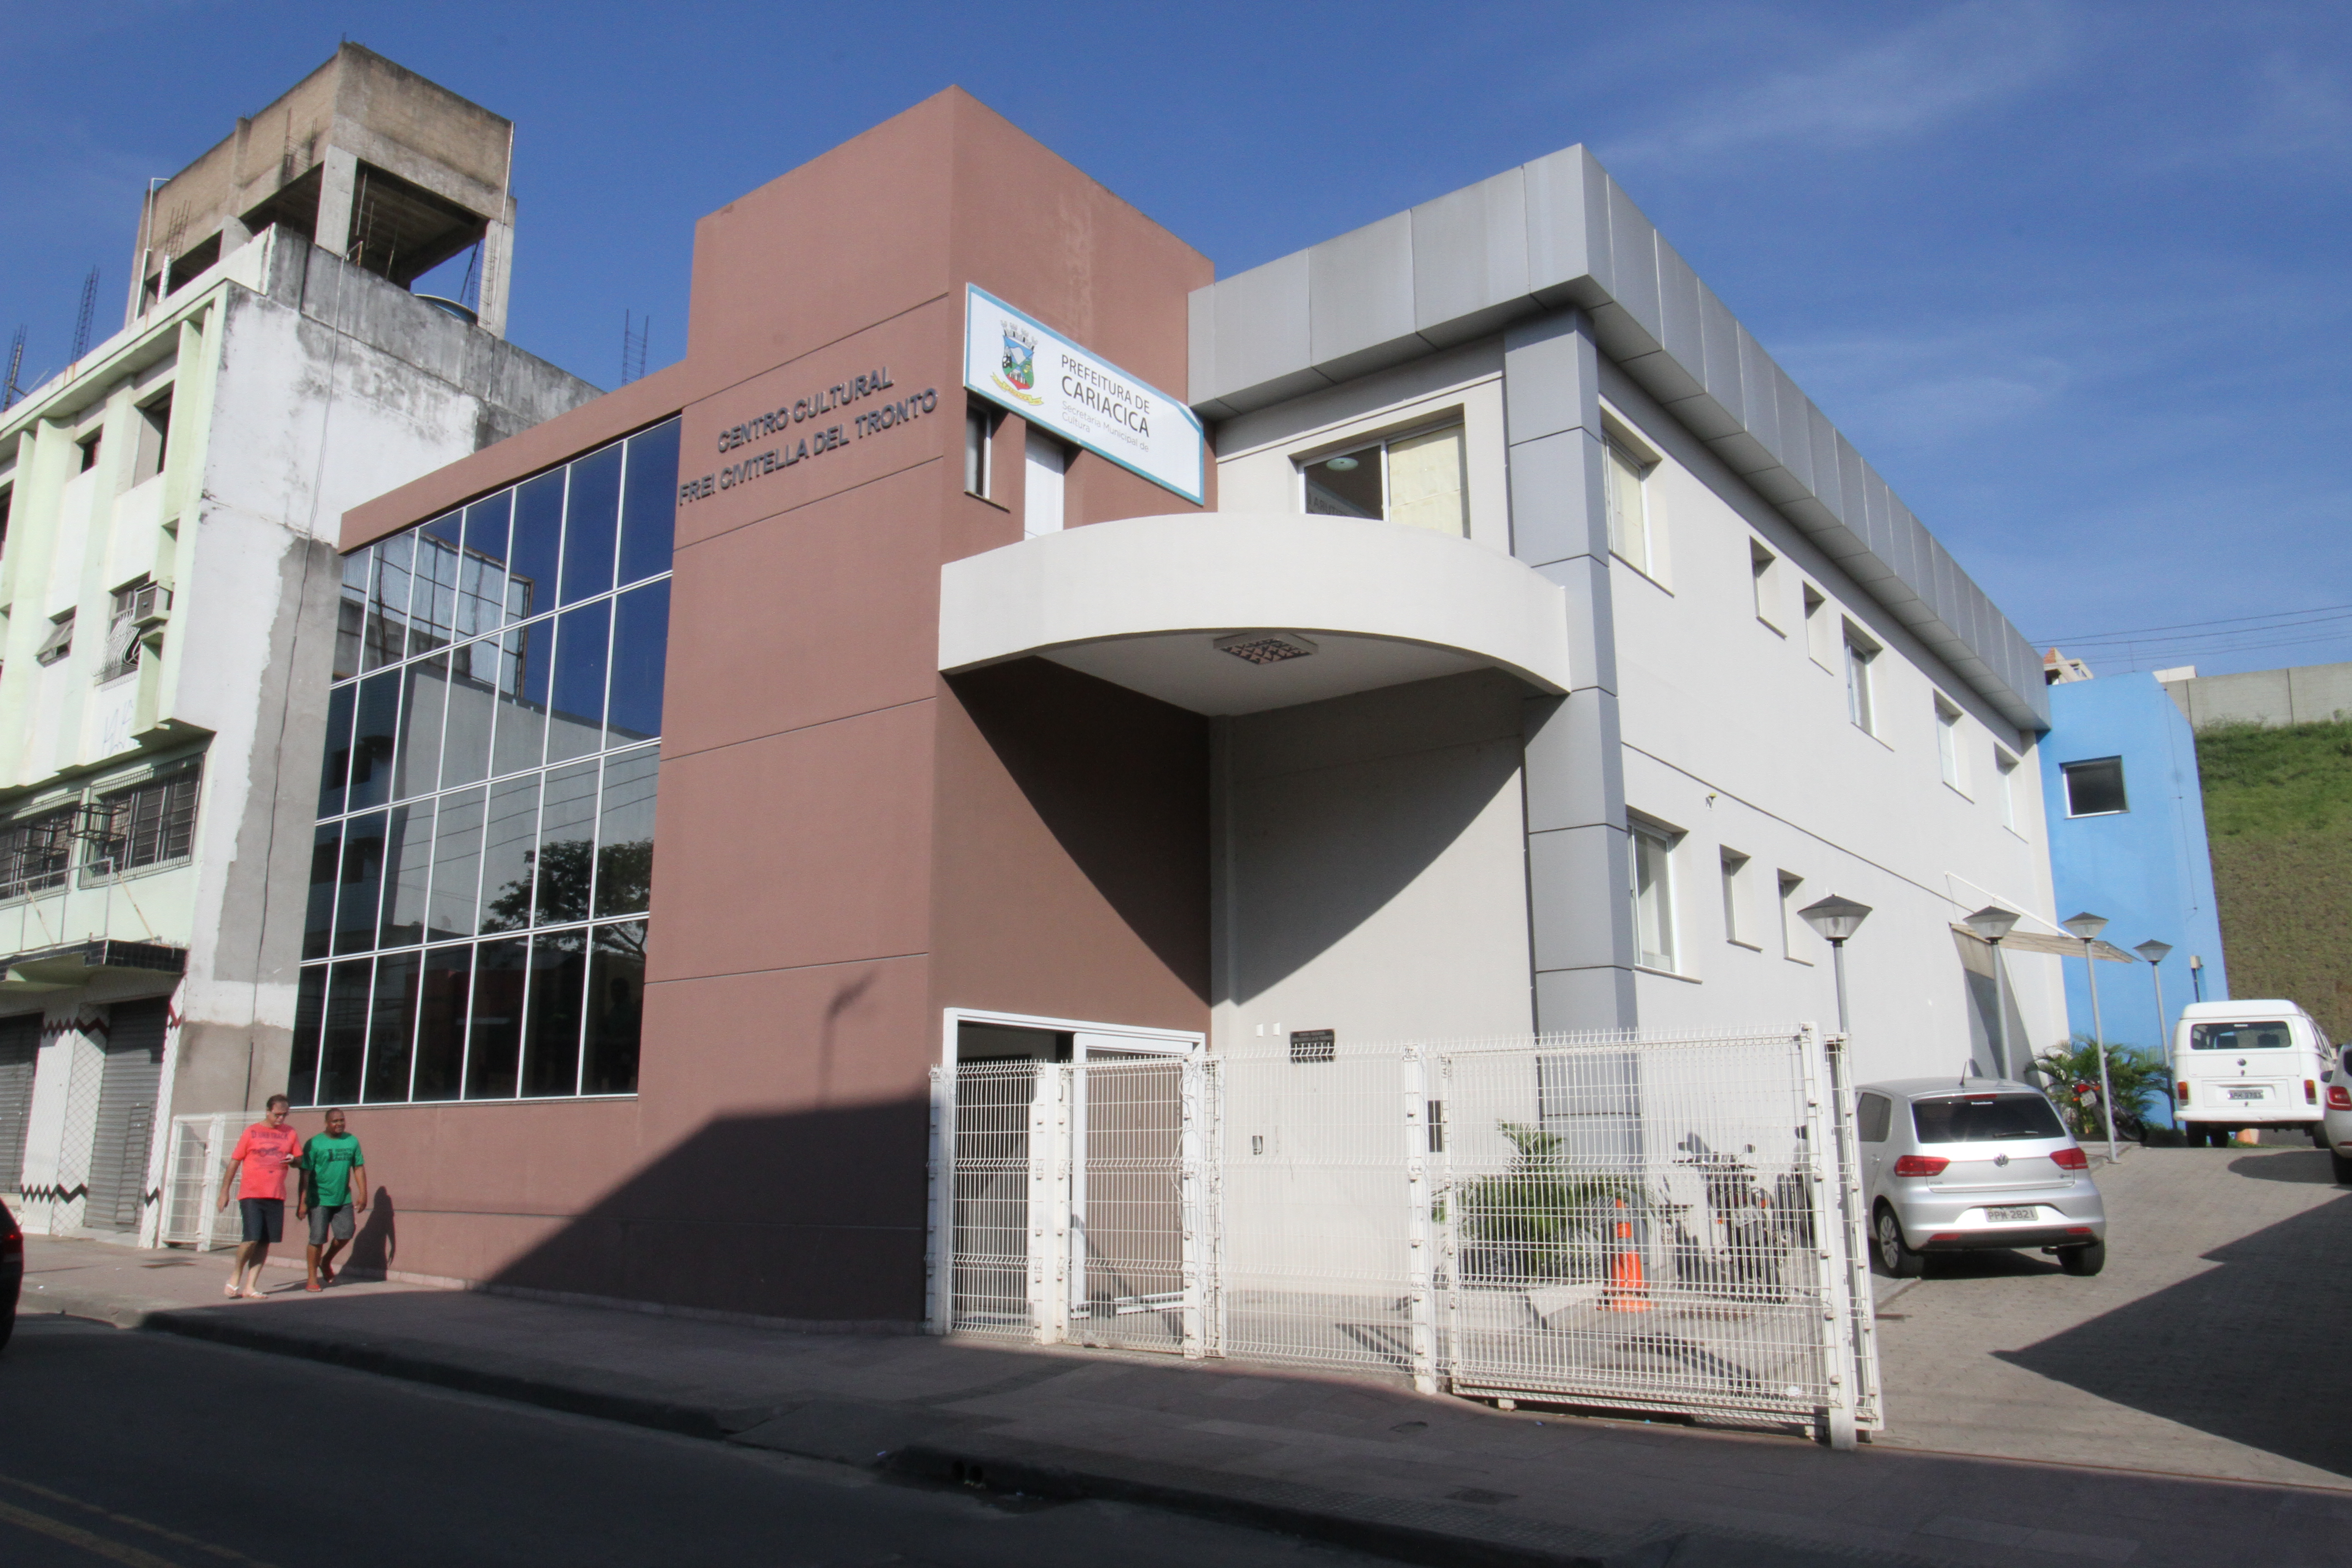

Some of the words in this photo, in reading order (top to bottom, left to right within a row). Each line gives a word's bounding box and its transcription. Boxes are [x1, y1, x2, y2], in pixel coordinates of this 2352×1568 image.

[718, 407, 789, 453] CENTRO
[794, 366, 894, 422] CULTURAL
[1061, 354, 1132, 405] PREFEITURA
[1135, 395, 1150, 415] DE
[1061, 375, 1150, 438] CARIACICA
[679, 473, 715, 507] FREI
[720, 438, 809, 490] CIVITELLA
[813, 424, 850, 456] DEL
[855, 387, 938, 439] TRONTO
[1062, 412, 1090, 433] Cultura
[1062, 400, 1102, 428] Secretaria
[1103, 421, 1138, 447] Municipal
[1139, 442, 1149, 452] de
